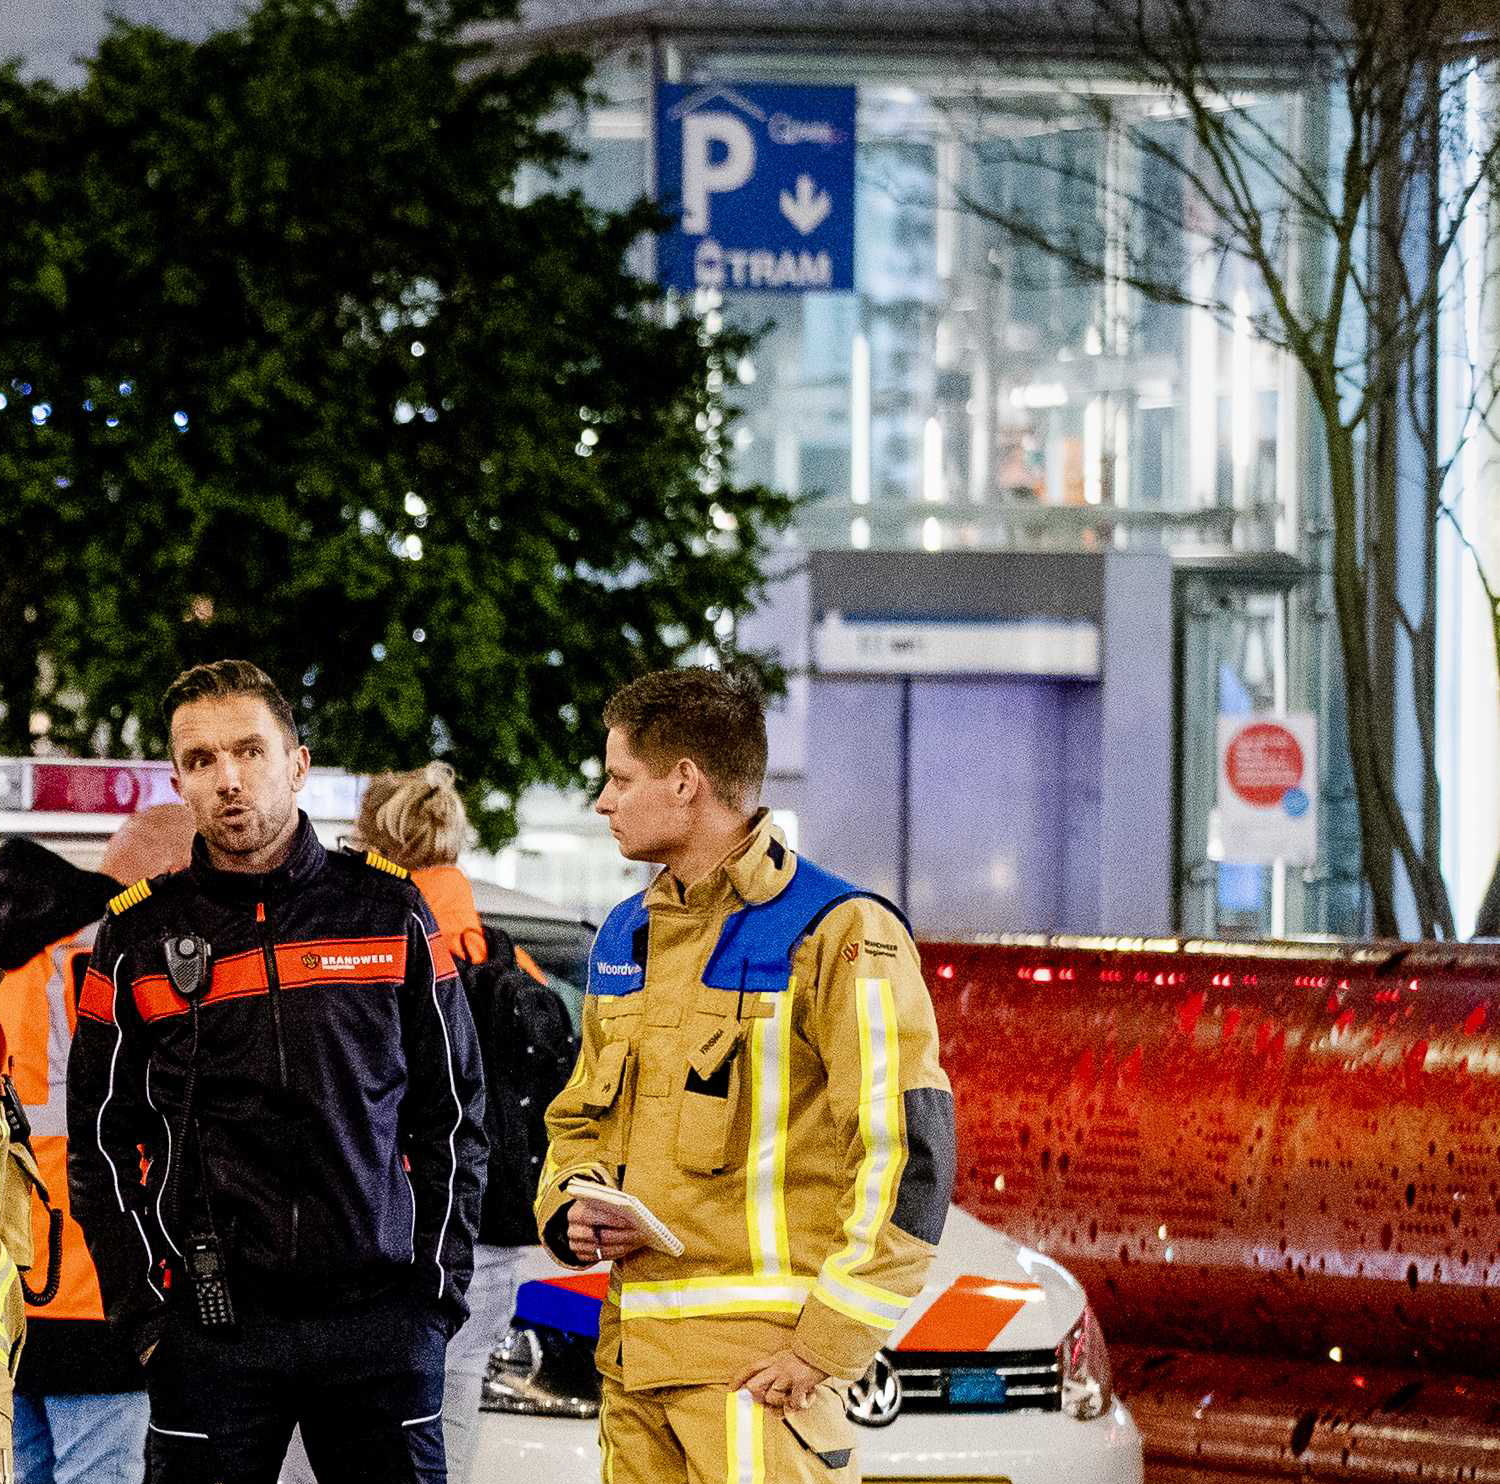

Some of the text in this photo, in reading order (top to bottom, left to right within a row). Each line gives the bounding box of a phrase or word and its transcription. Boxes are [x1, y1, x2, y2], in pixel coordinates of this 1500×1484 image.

[681, 112, 758, 236] P
[725, 249, 834, 288] TRAM
[321, 954, 393, 965] BRANDWEER
[597, 961, 643, 976] Woordv
